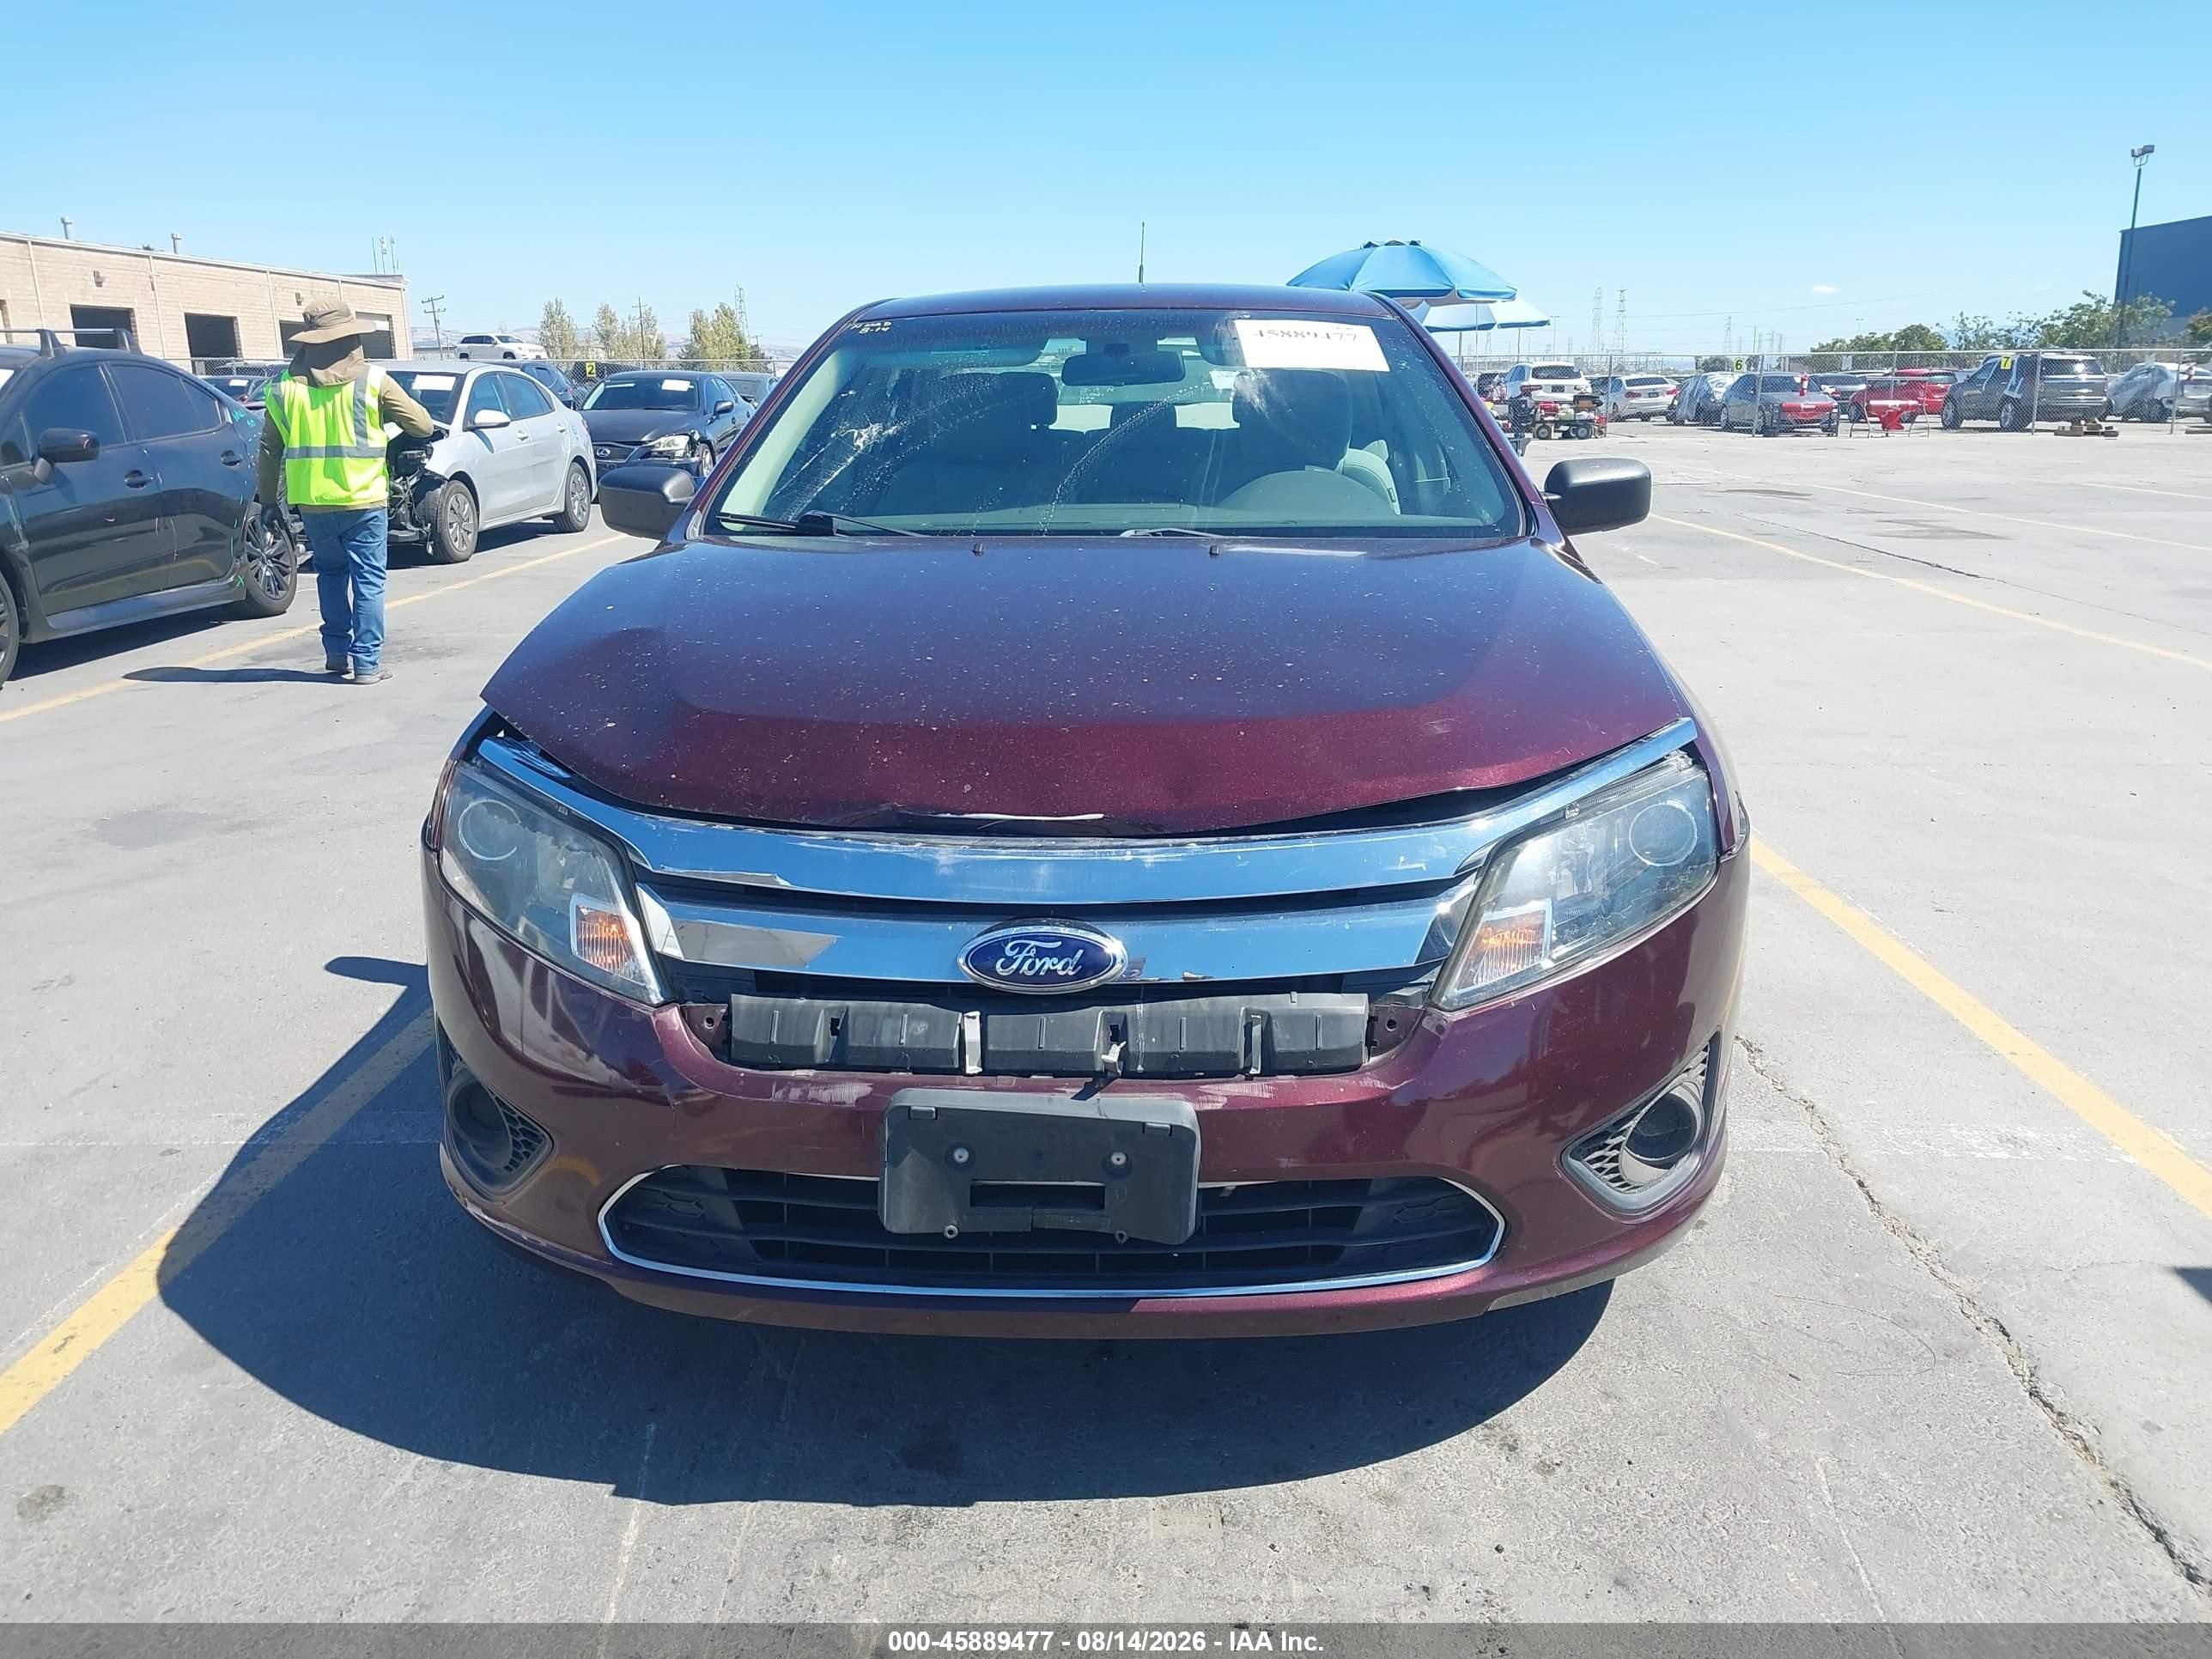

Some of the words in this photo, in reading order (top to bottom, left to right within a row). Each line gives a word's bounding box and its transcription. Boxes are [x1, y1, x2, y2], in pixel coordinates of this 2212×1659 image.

[1735, 359, 1743, 371] 6
[2003, 356, 2011, 368] 7
[587, 364, 595, 375] 2
[996, 939, 1085, 977] Ford
